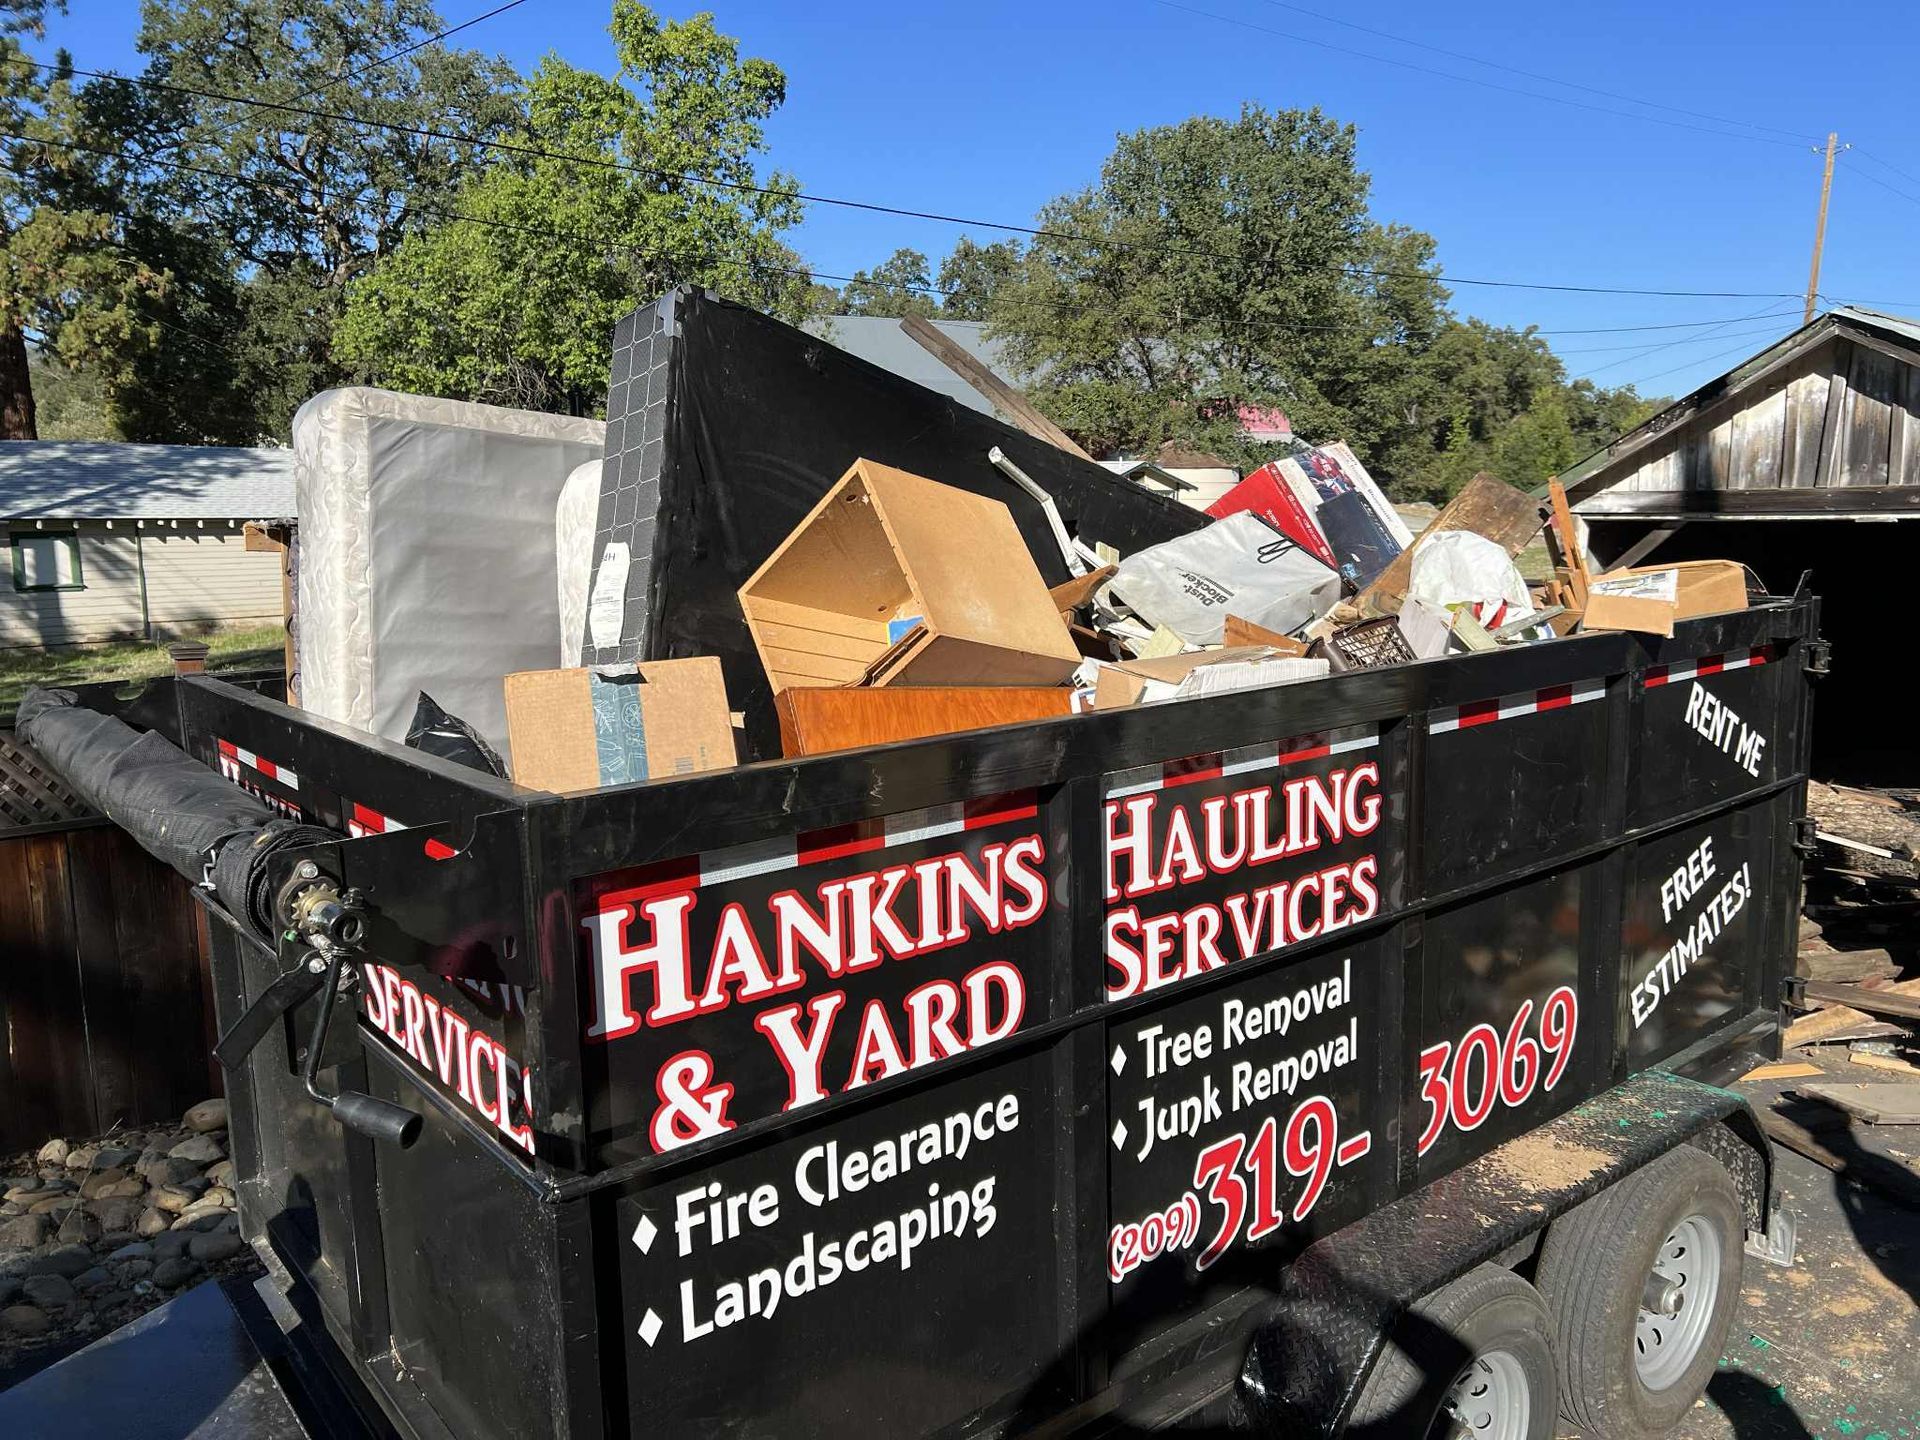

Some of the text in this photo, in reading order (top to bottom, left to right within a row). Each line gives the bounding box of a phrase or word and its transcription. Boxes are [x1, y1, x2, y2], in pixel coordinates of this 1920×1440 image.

[1180, 573, 1229, 604] Blocker
[1684, 681, 1767, 778] RENT ME
[1105, 761, 1382, 905] HAULING
[1660, 836, 1717, 925] FREE
[581, 832, 1048, 1042] HANKINS
[1104, 855, 1378, 1003] SERVICES
[1630, 862, 1752, 1030] ESTIMATES!
[650, 960, 1026, 1155] & YARD
[1137, 1017, 1358, 1163] Junk Removal
[1138, 958, 1352, 1079] Tree Removal
[674, 1093, 1020, 1259] Fire Clearance
[1106, 1190, 1201, 1283] (209)
[1418, 986, 1579, 1158] 3069
[680, 1176, 998, 1344] Landscaping
